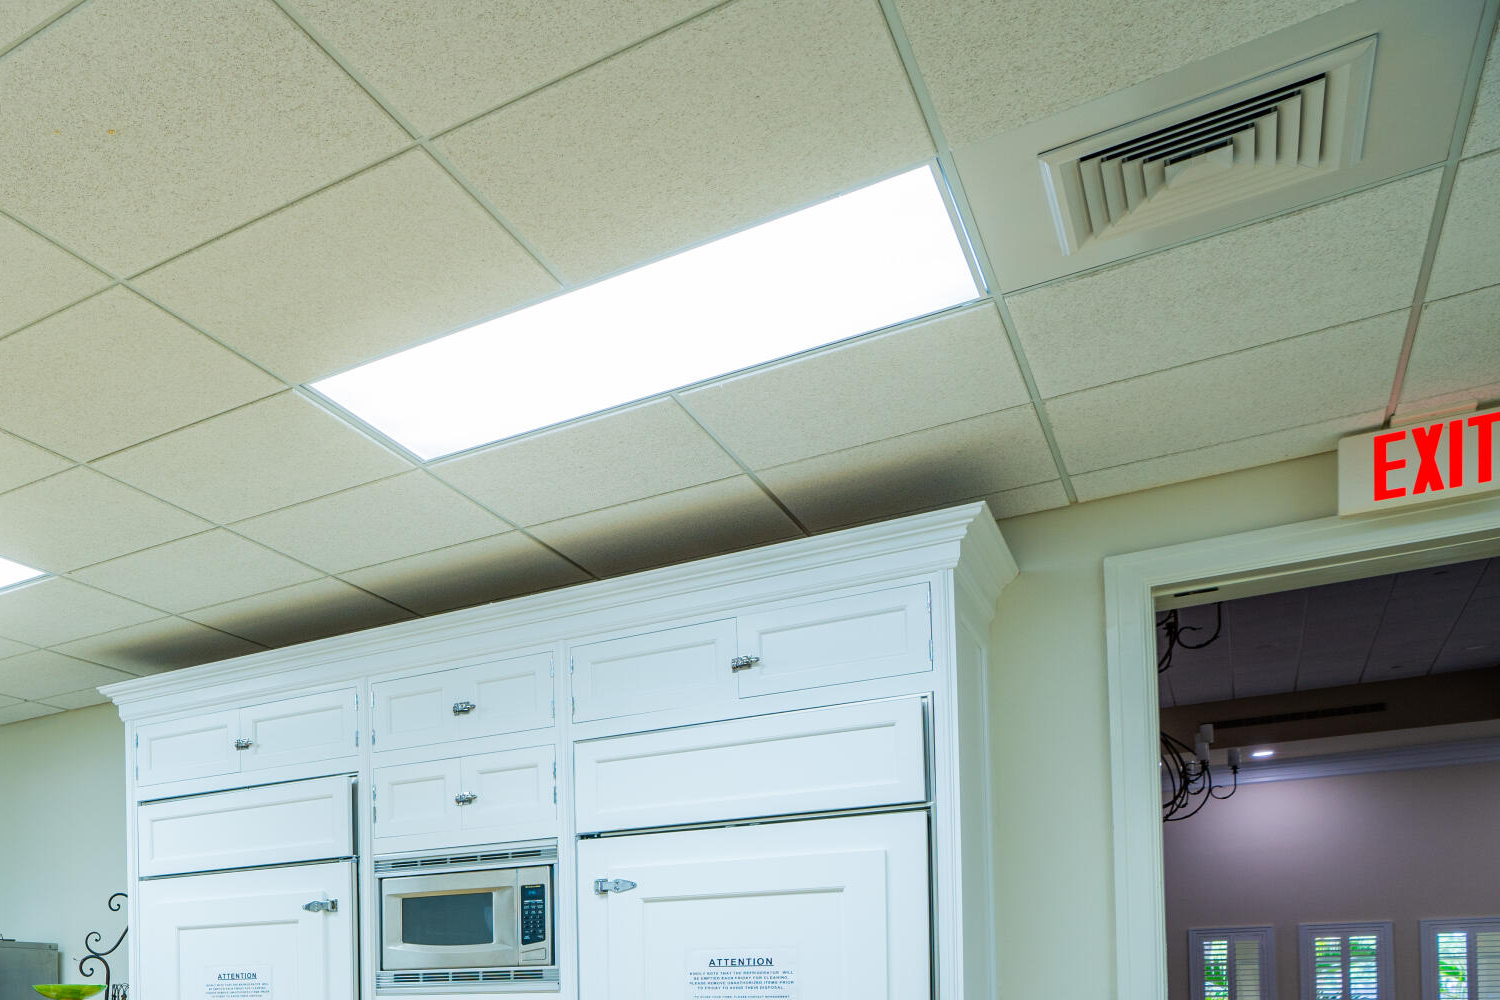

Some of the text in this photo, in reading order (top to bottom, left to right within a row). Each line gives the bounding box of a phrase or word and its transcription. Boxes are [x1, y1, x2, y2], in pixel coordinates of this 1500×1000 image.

[1374, 412, 1500, 501] EXIT
[708, 958, 774, 966] ATTENTION
[218, 972, 257, 980] ATTENTION
